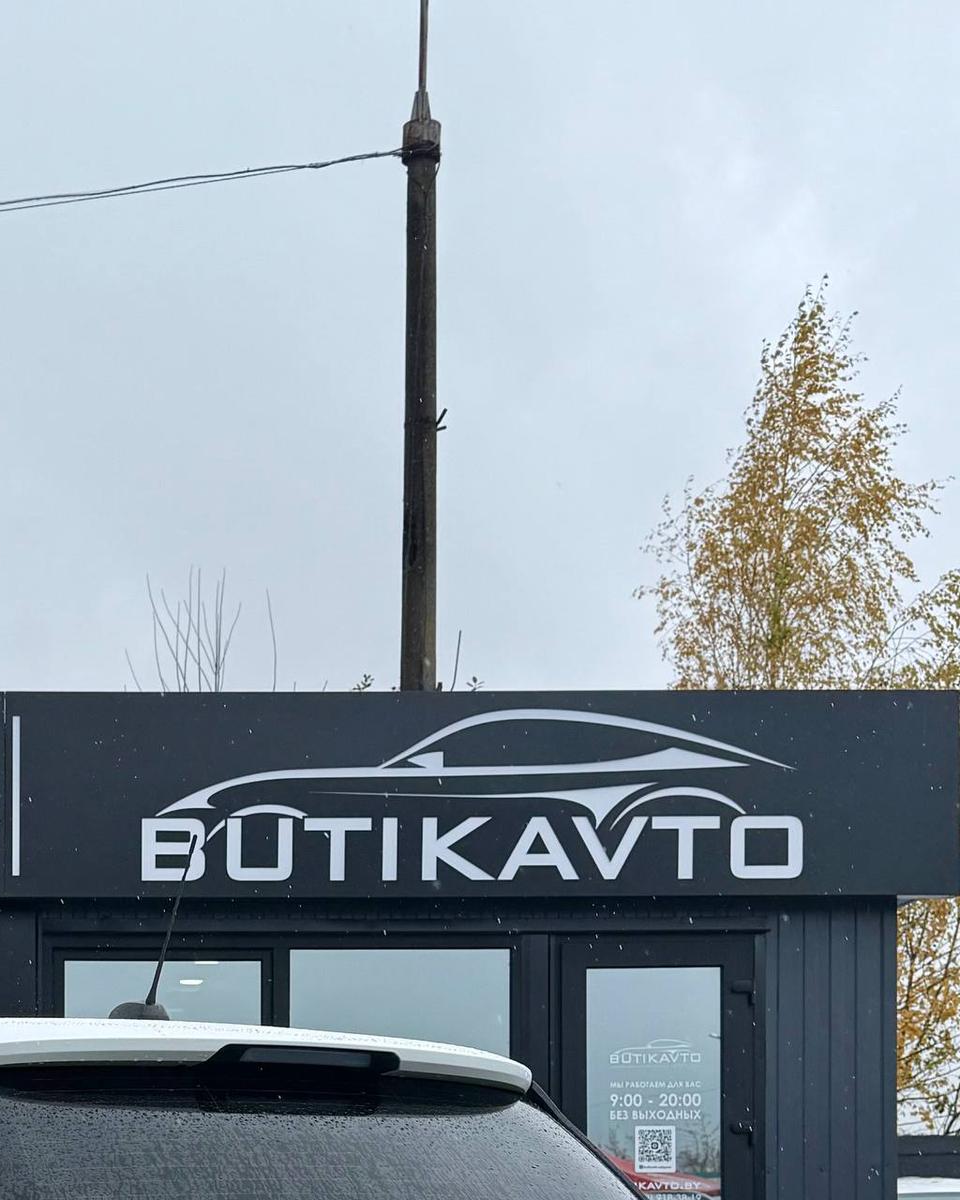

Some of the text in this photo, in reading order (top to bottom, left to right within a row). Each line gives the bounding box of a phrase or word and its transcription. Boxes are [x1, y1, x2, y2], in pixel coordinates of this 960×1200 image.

[140, 815, 804, 882] BUTIKAVTO
[609, 1052, 701, 1064] BUTIKAVTO
[610, 1093, 642, 1107] 9:00
[659, 1093, 701, 1107] 20:00
[610, 1110, 701, 1120] БЕЗ ВЫХОДНЫХ
